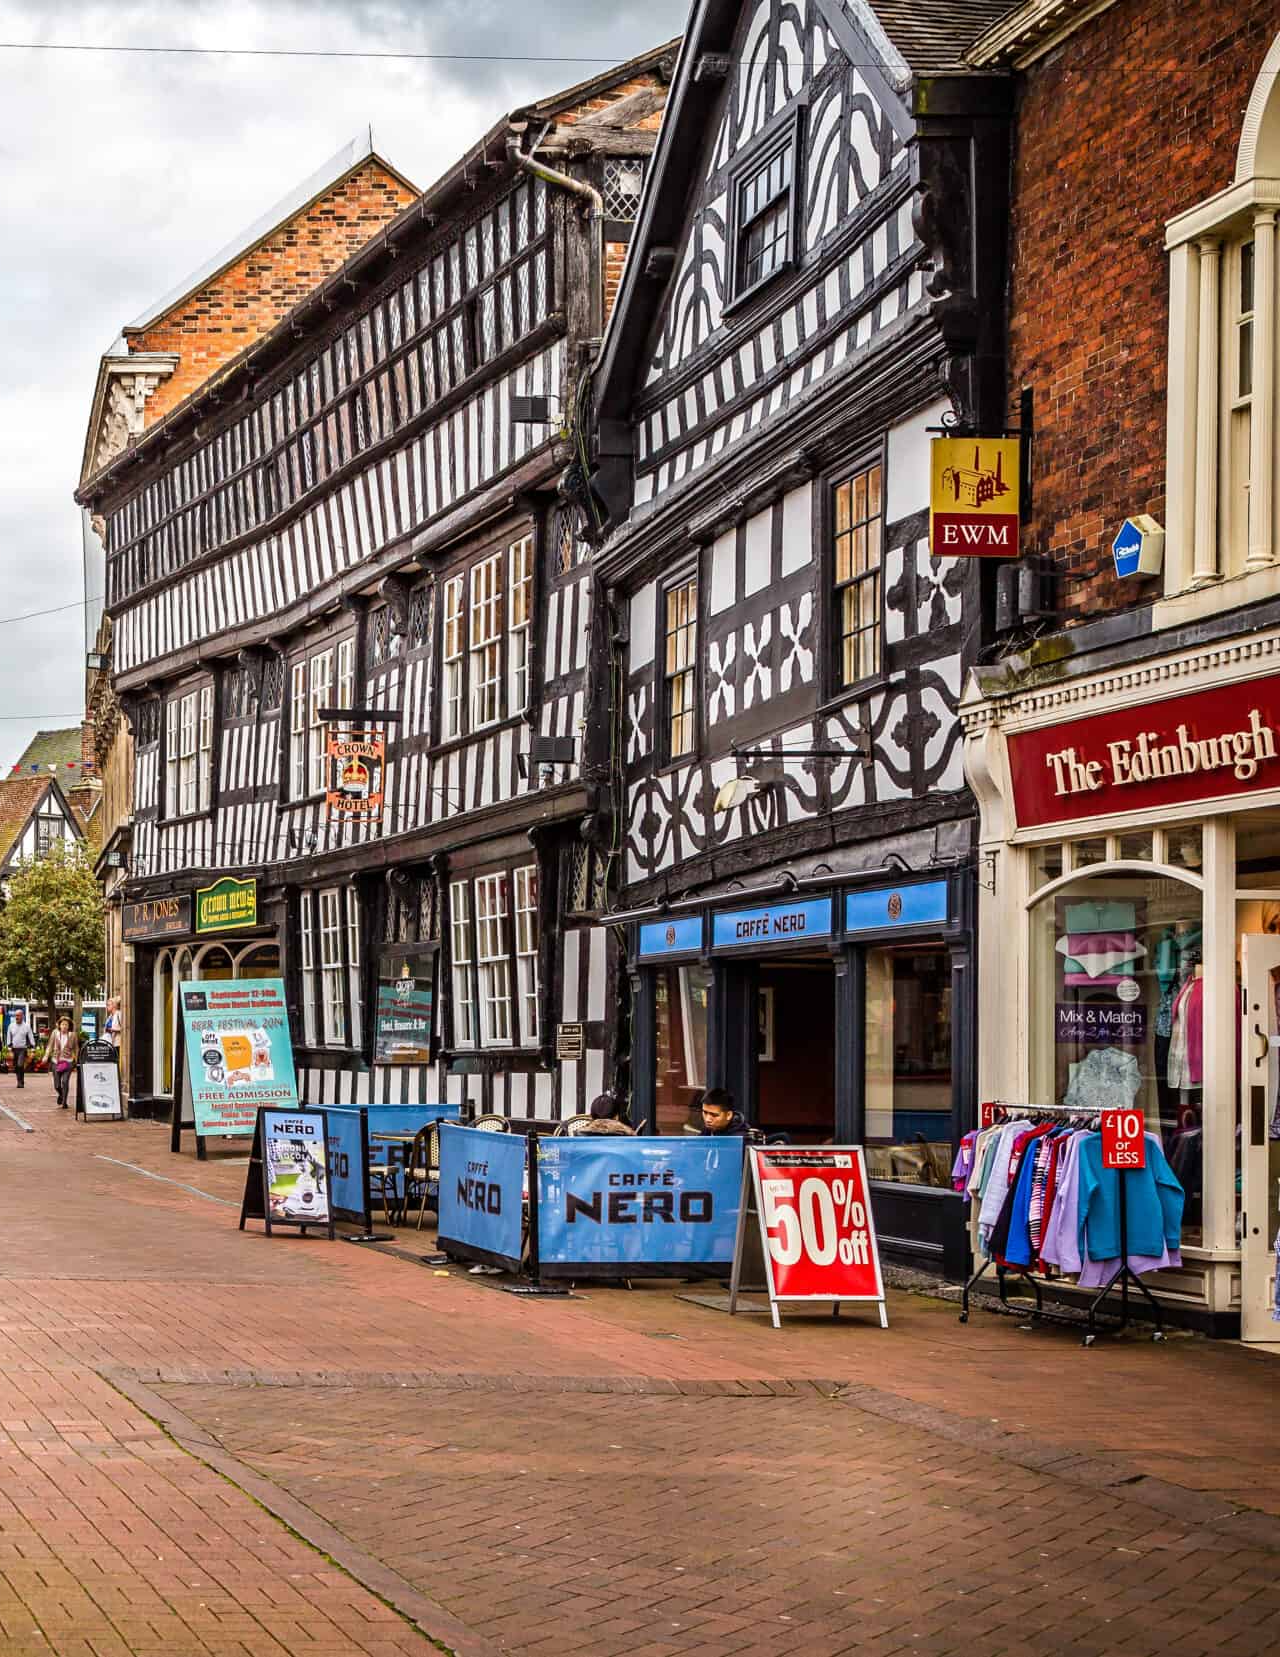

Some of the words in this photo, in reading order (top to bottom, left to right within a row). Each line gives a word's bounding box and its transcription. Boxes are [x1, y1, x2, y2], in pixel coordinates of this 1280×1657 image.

[942, 524, 1009, 545] EWM
[337, 744, 375, 756] CROWN
[1046, 747, 1104, 796] The
[1107, 709, 1278, 780] Edinburgh
[337, 799, 373, 810] HOTEL
[152, 897, 180, 923] JONES
[774, 913, 807, 932] NERO
[218, 1018, 257, 1031] FESTIVAL
[1060, 1010, 1083, 1023] Mix
[1086, 1010, 1096, 1023] &
[1099, 1010, 1142, 1024] Match
[199, 1092, 224, 1100] FREE
[228, 1089, 291, 1099] ADMISSION
[273, 1124, 314, 1135] NERO
[1106, 1114, 1139, 1138] £10
[1115, 1142, 1131, 1150] or
[327, 1151, 349, 1178] ERO
[777, 1157, 801, 1165] Edinburgh
[1109, 1151, 1139, 1165] LESS
[609, 1168, 675, 1186] CAFFÈ
[457, 1176, 502, 1216] NERO
[566, 1191, 713, 1224] NERO
[765, 1177, 866, 1266] 50%
[839, 1229, 869, 1266] off
